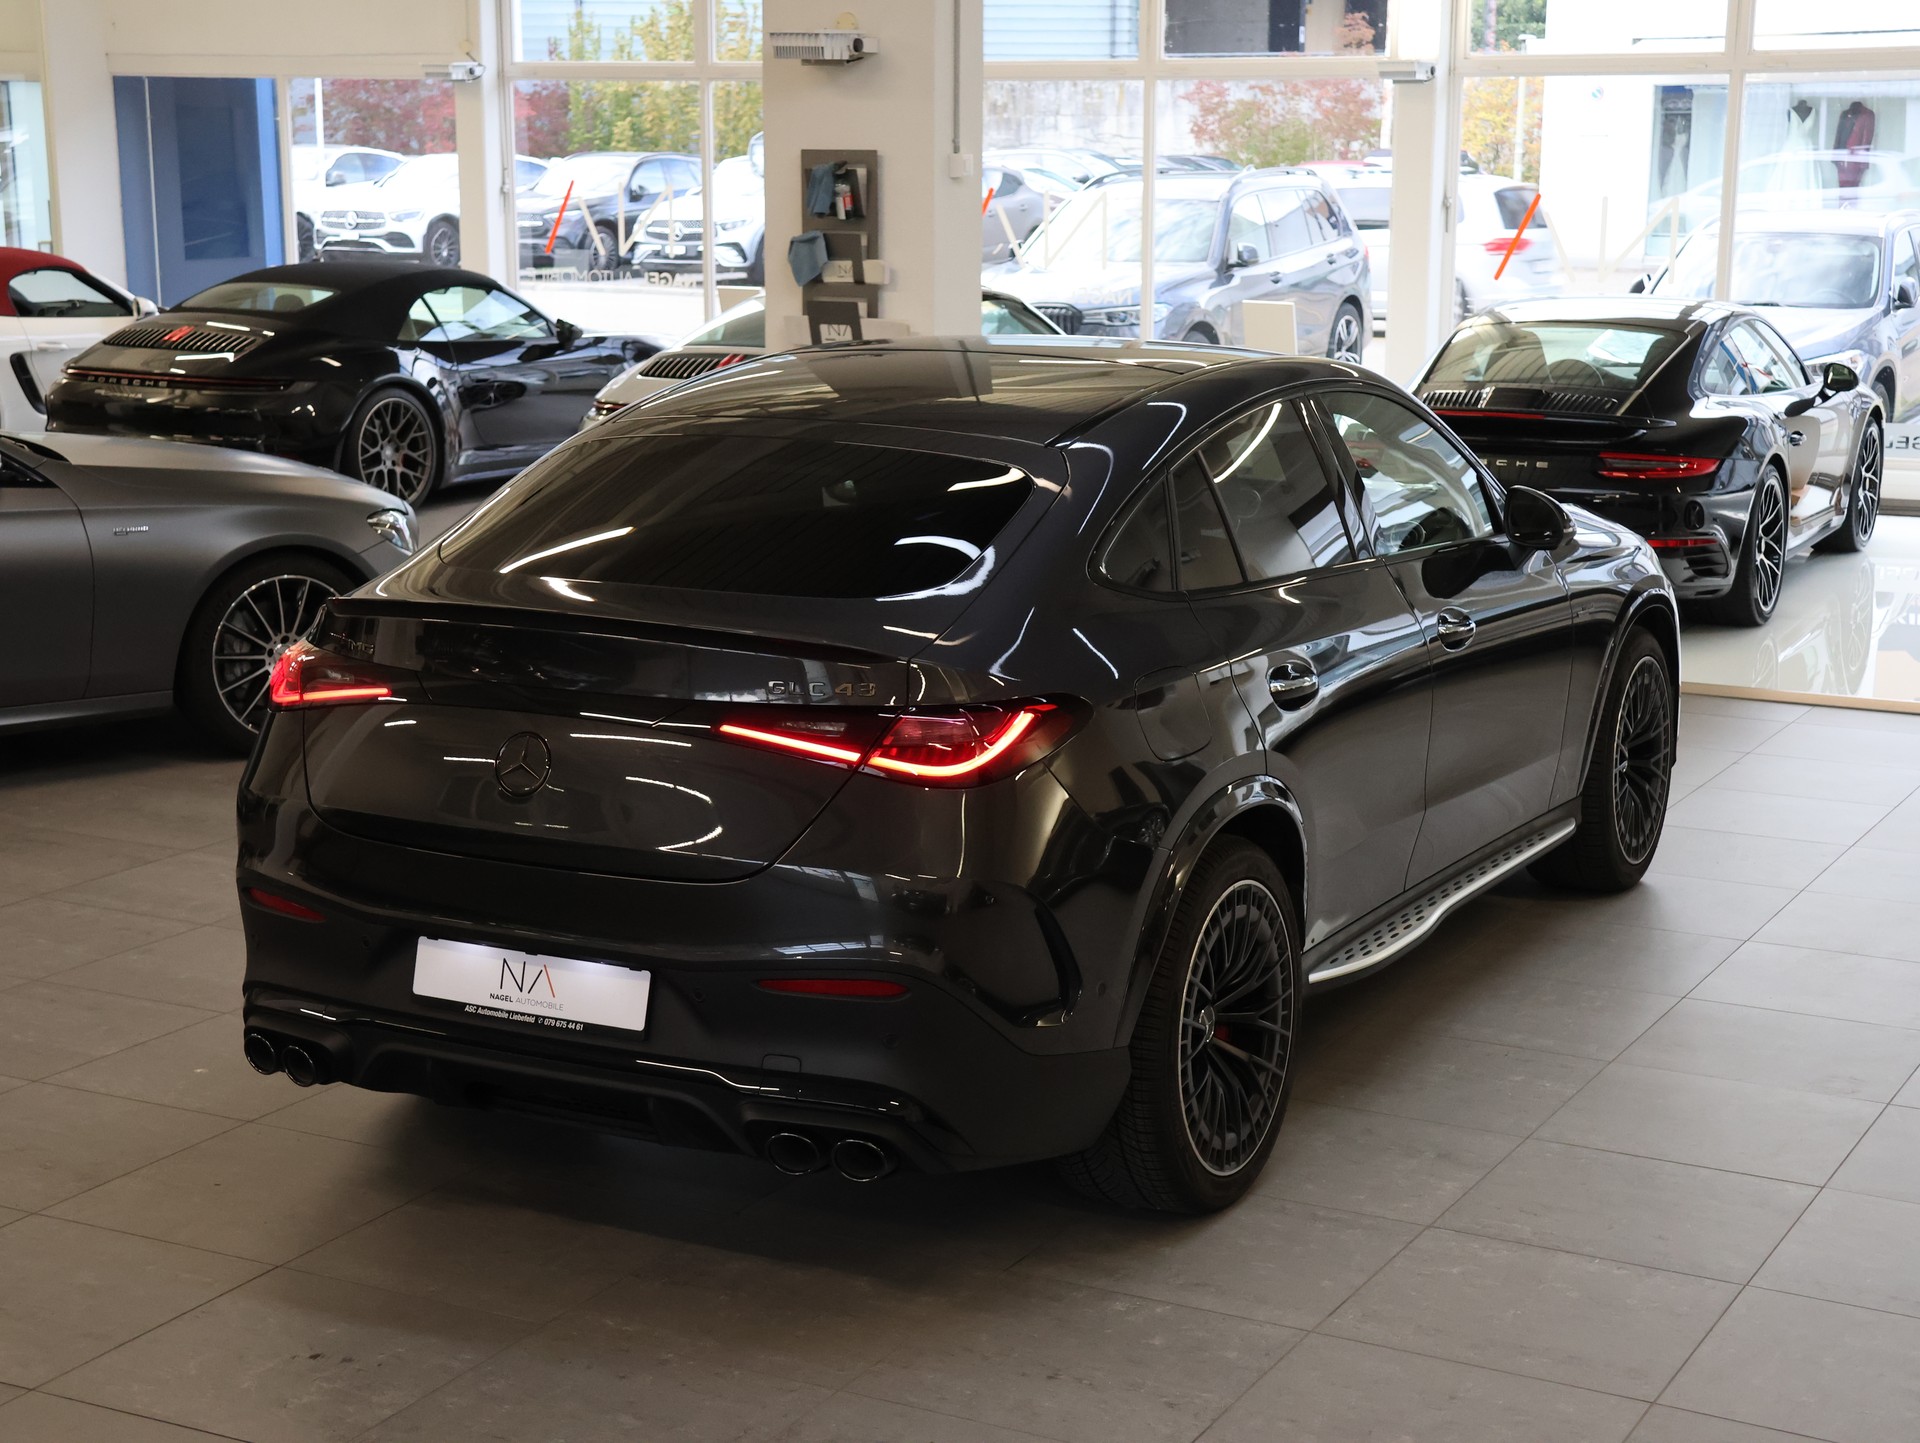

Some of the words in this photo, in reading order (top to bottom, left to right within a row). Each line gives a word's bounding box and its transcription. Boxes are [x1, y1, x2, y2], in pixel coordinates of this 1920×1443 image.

[87, 375, 168, 388] PORSCHE
[767, 680, 826, 697] GLC
[834, 682, 877, 697] 43
[489, 992, 514, 1003] NAGEL
[515, 996, 564, 1012] AUTOMOBILE
[464, 1004, 477, 1013] ASC
[477, 1006, 509, 1019] Automobile
[509, 1012, 536, 1024] Liebefeld
[543, 1017, 556, 1027] 079
[555, 1020, 567, 1029] 675
[567, 1022, 576, 1030] 44
[575, 1023, 584, 1031] 61
